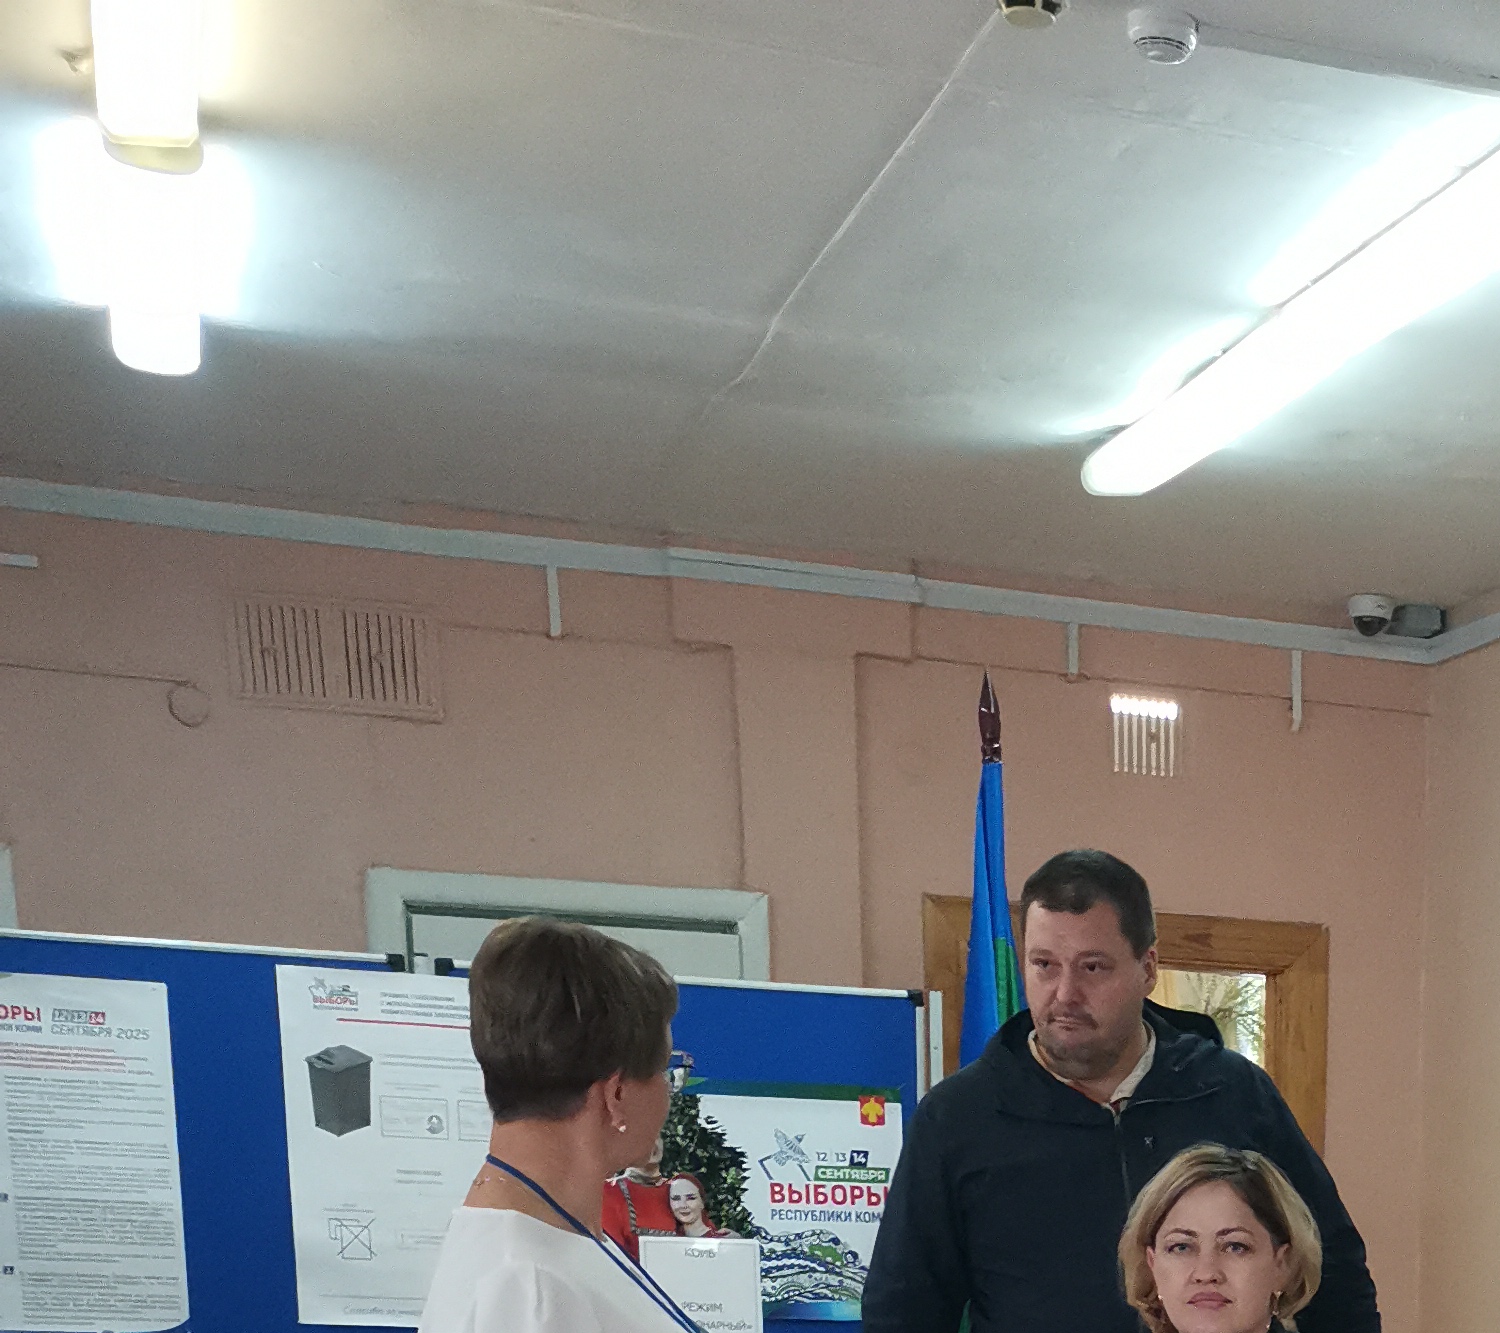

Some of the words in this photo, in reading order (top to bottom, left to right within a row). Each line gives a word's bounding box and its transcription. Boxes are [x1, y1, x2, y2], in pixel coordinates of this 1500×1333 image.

[50, 1023, 113, 1038] СЕНТЯБРЯ
[115, 1026, 151, 1041] 2025
[816, 1151, 828, 1162] 12
[834, 1152, 847, 1163] 13
[852, 1152, 867, 1165] 14
[817, 1168, 886, 1181] СЕНТЯБРЯ
[769, 1181, 889, 1207] ВЫБОРЫ
[770, 1208, 852, 1223] РЕСПУБЛИКИ
[855, 1210, 881, 1224] КОМ
